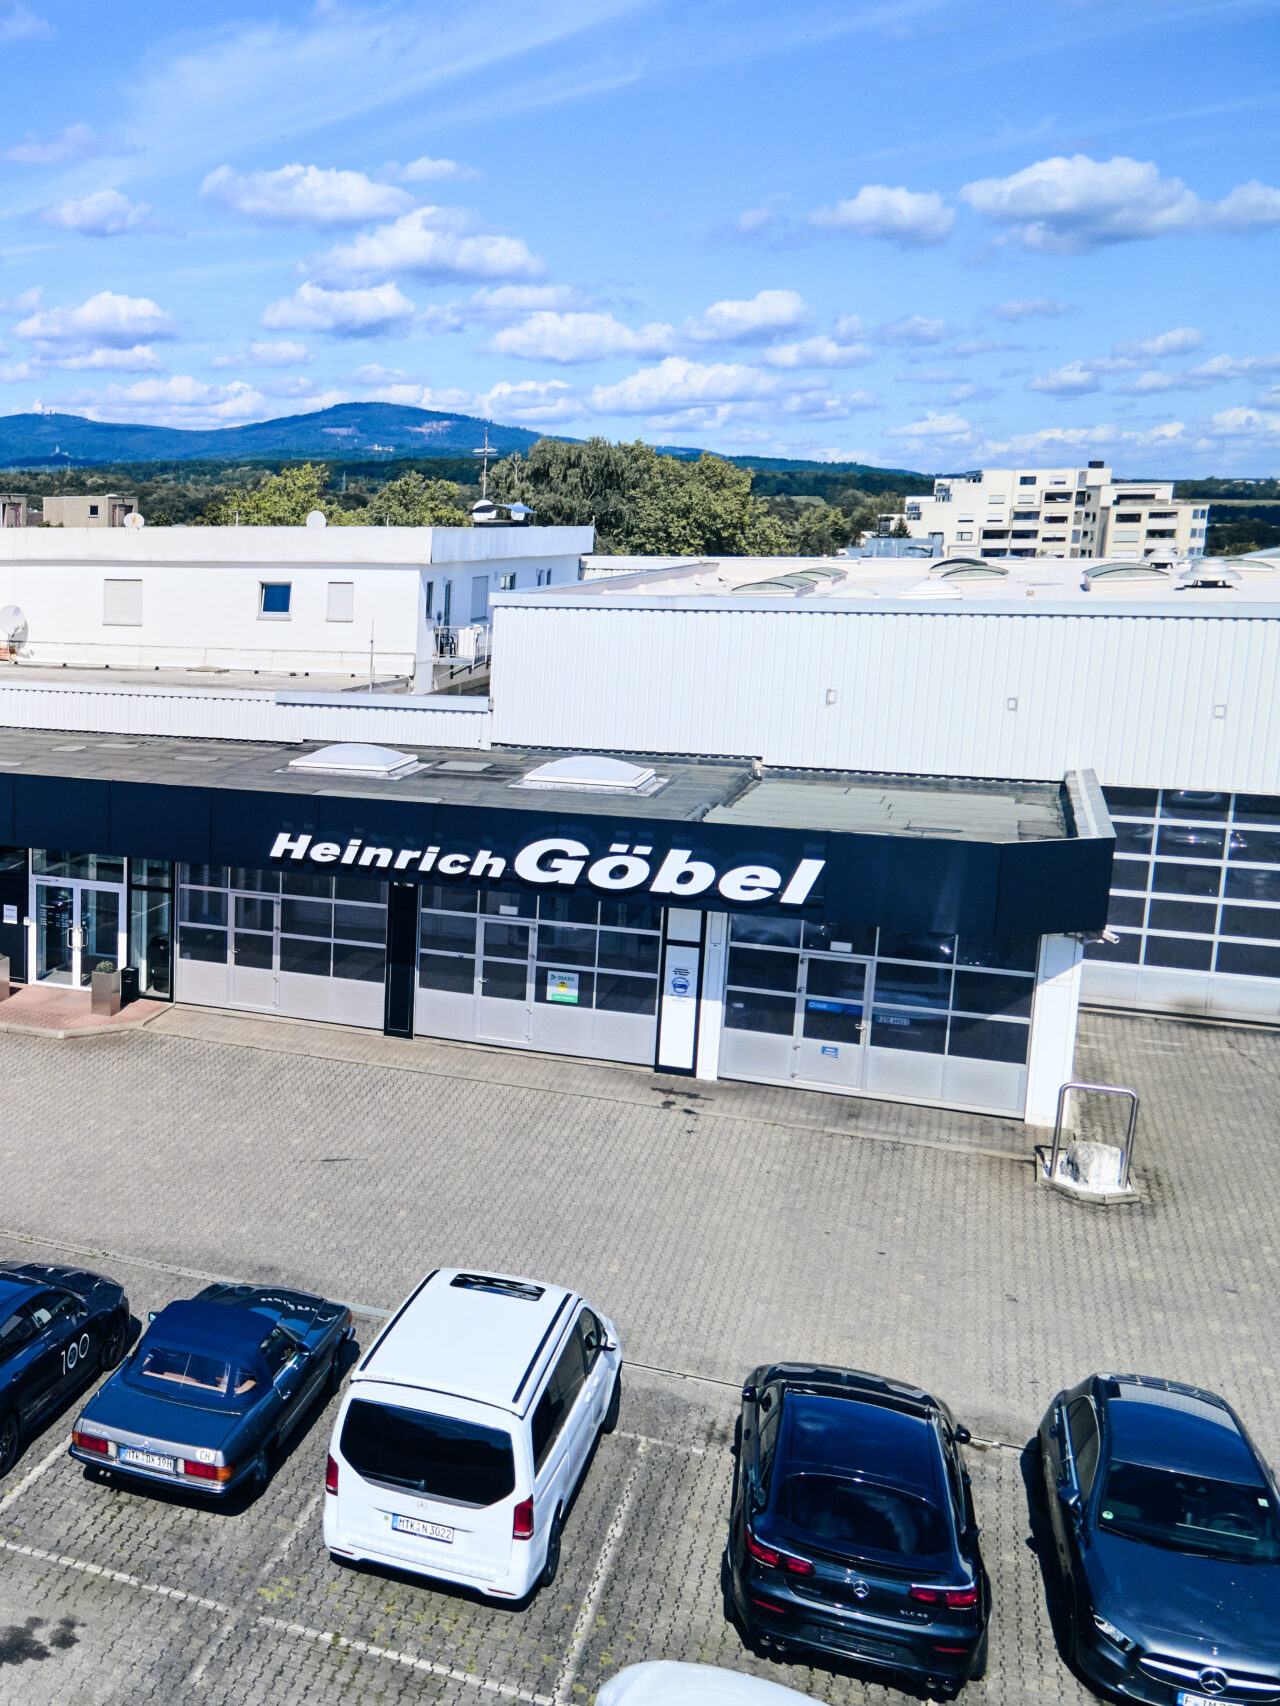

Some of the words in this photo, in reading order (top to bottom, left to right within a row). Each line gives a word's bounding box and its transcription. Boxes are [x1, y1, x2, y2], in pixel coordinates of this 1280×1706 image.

[269, 832, 508, 879] Heinrich
[513, 837, 827, 905] Göbel
[60, 1332, 90, 1376] 100
[200, 1450, 211, 1462] CH
[399, 1518, 415, 1531] MTK
[422, 1523, 428, 1534] N
[429, 1525, 452, 1540] 3022
